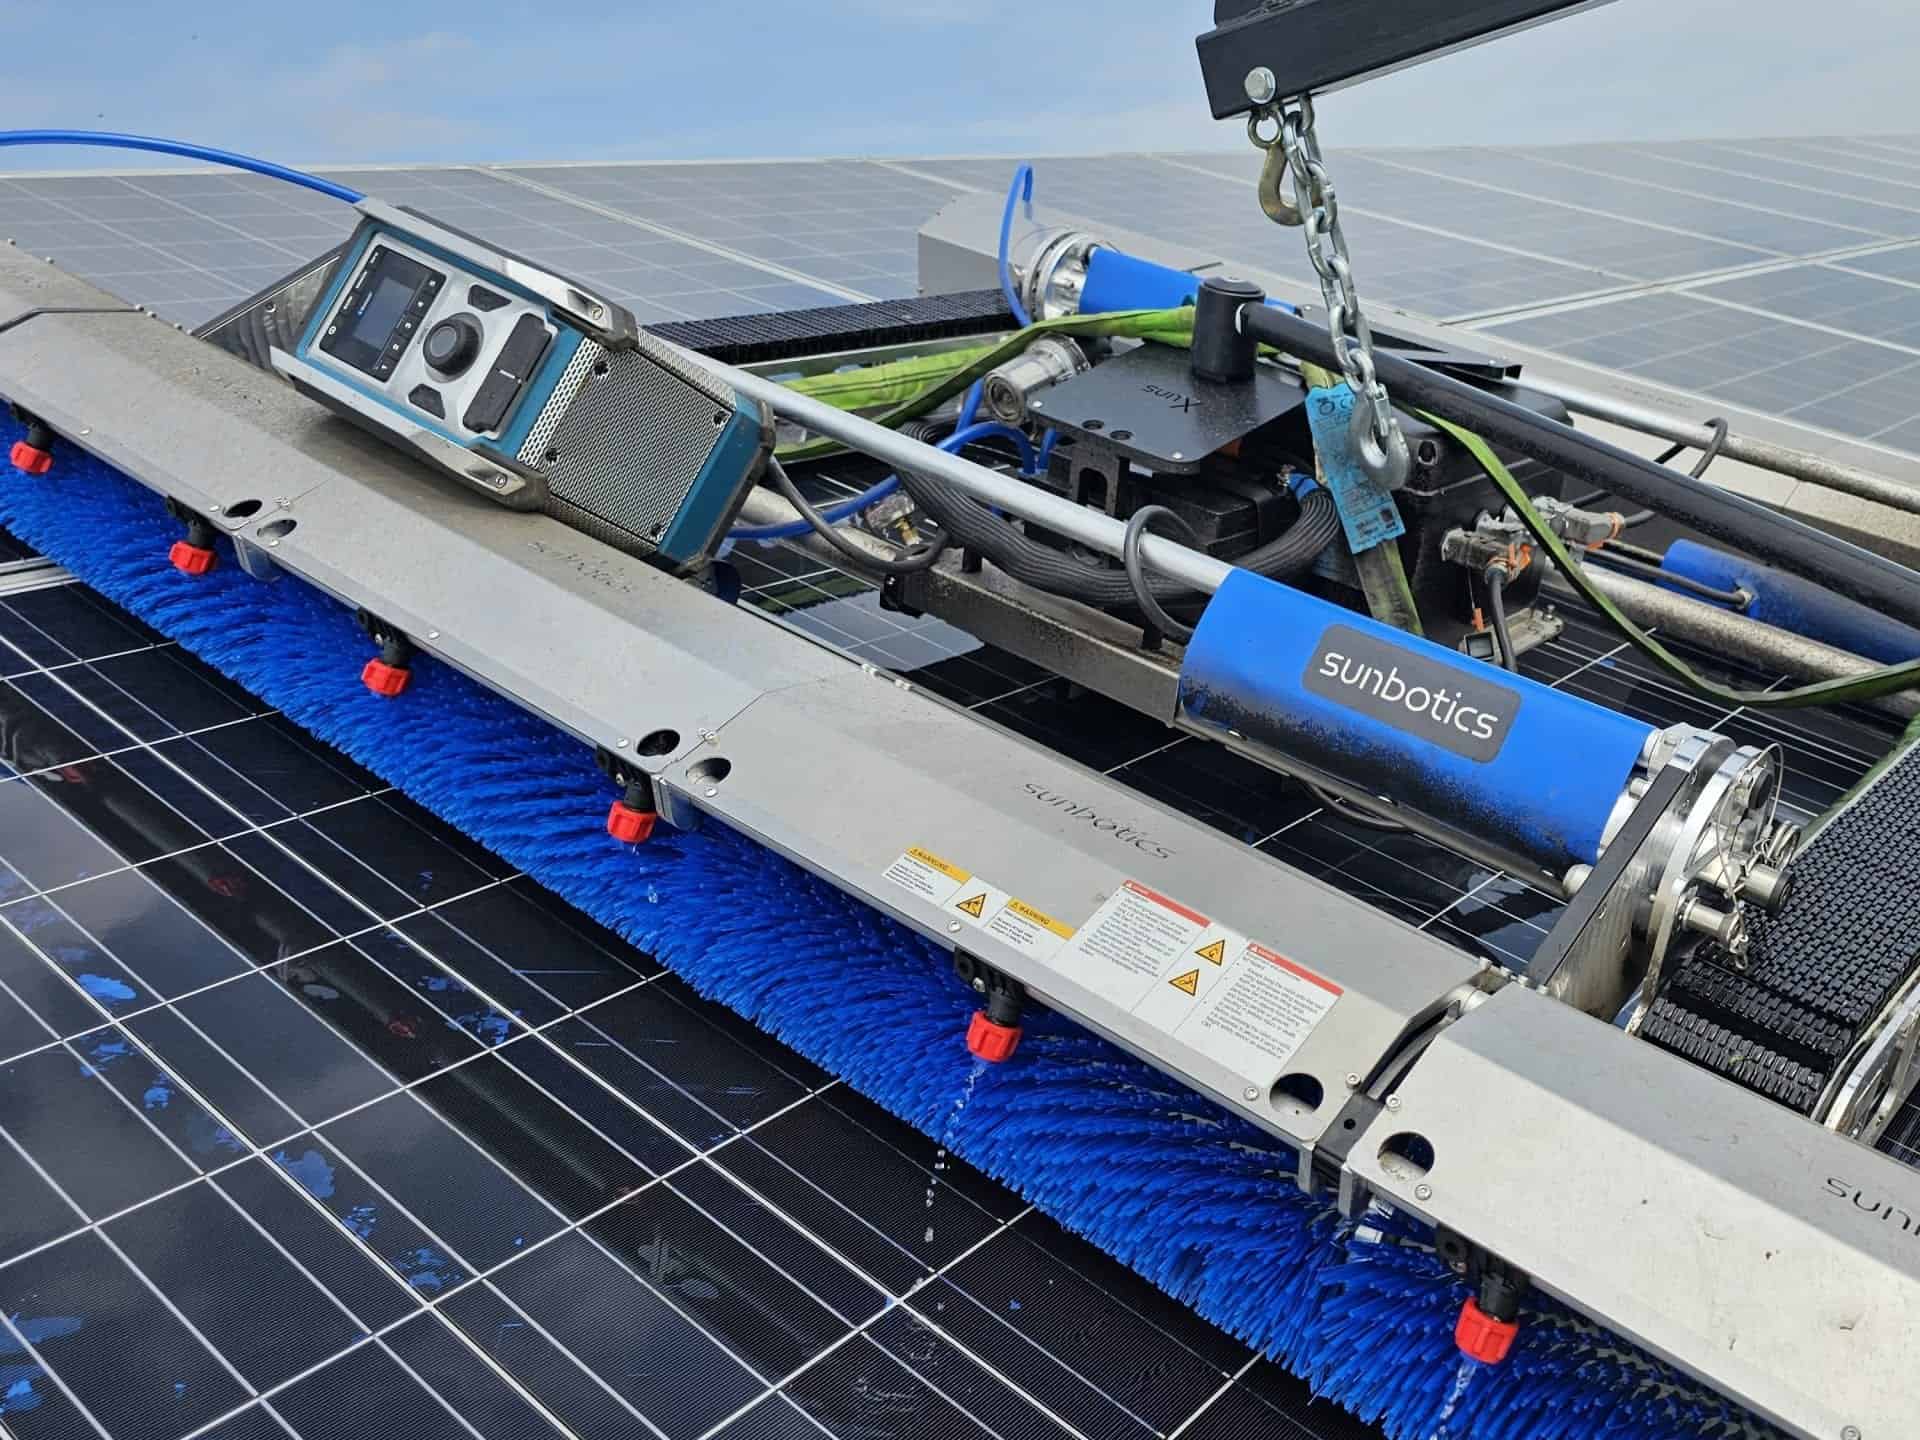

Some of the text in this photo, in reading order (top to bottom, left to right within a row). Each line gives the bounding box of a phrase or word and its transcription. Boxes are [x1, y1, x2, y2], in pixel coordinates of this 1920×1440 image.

[1319, 652, 1498, 740] sunbotics
[1023, 783, 1177, 859] sunbotics
[1821, 1177, 1920, 1236] sun
